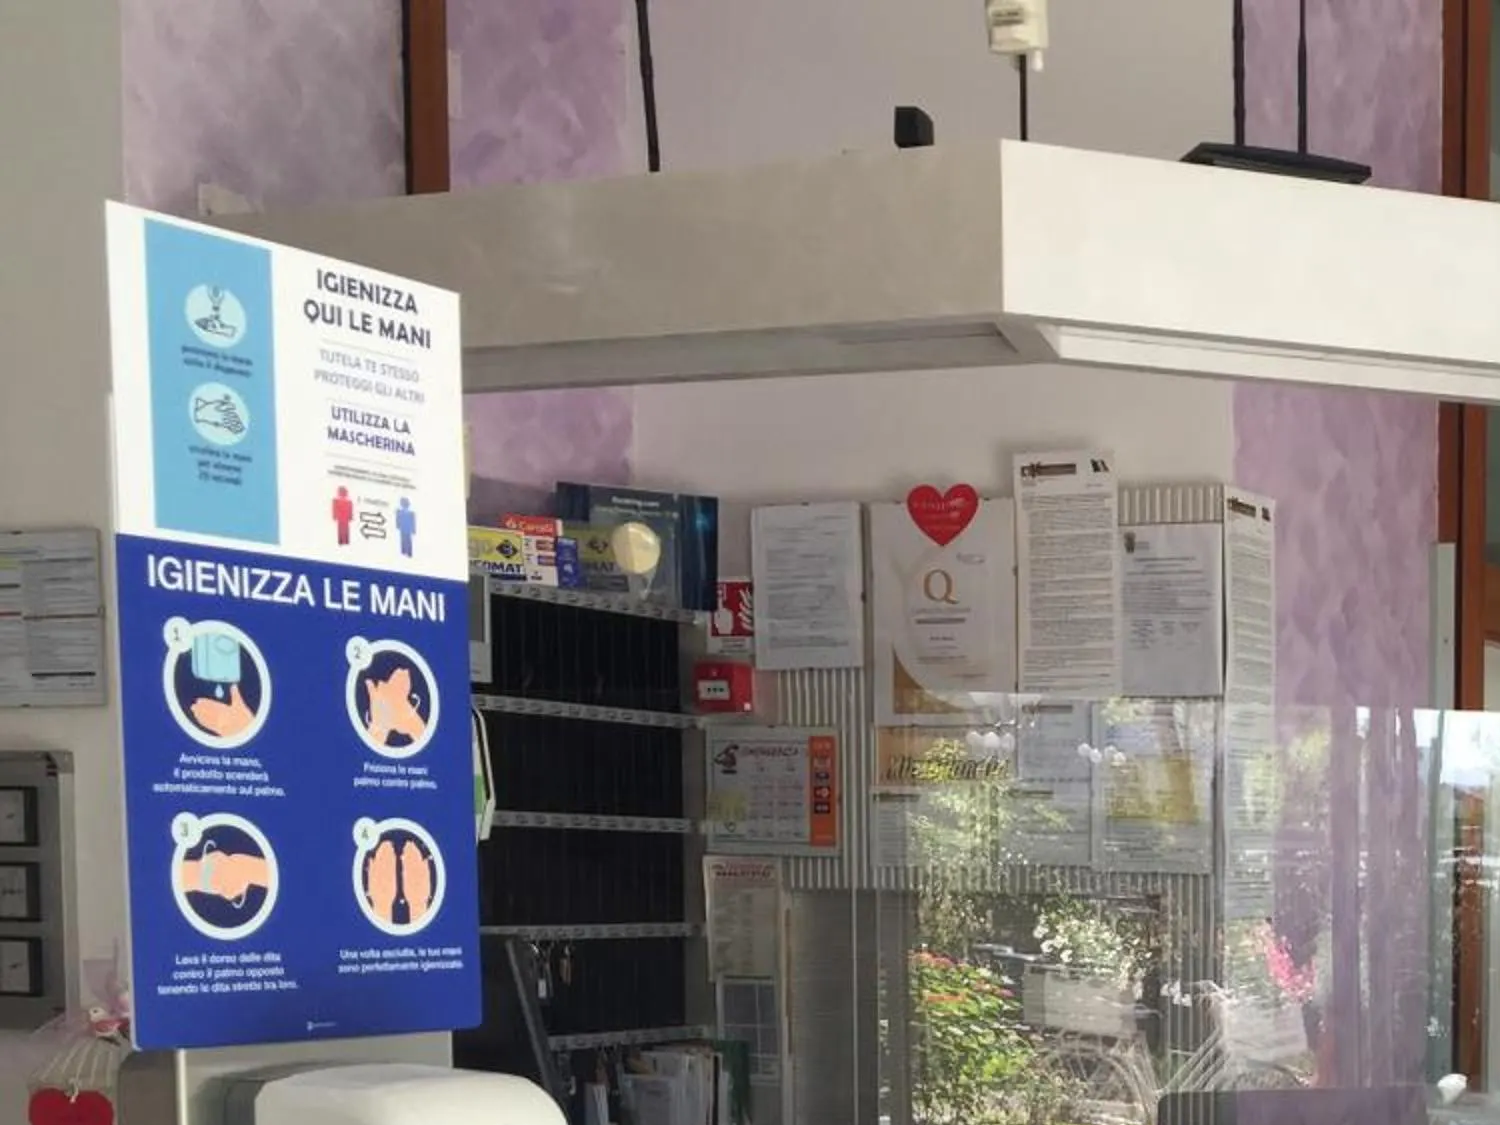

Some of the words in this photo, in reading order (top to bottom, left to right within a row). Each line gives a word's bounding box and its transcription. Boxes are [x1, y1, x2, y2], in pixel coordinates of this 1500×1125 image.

[316, 267, 418, 315] IGIENIZZA
[303, 298, 342, 328] QUI
[349, 309, 373, 335] LE
[378, 316, 431, 349] MANI
[320, 348, 362, 371] TUTELA
[364, 357, 377, 374] TE
[380, 362, 419, 383] STESSO
[314, 368, 373, 394] PROTEGGI
[374, 380, 393, 398] GLI
[394, 387, 425, 404] ALTRI
[330, 404, 390, 431] UTILIZZA
[392, 417, 412, 435] LA
[326, 425, 416, 456] MASCHERINA
[147, 554, 315, 607] IGIENIZZA
[323, 577, 362, 612] LE
[369, 583, 446, 622] MANI
[923, 568, 959, 605] Q
